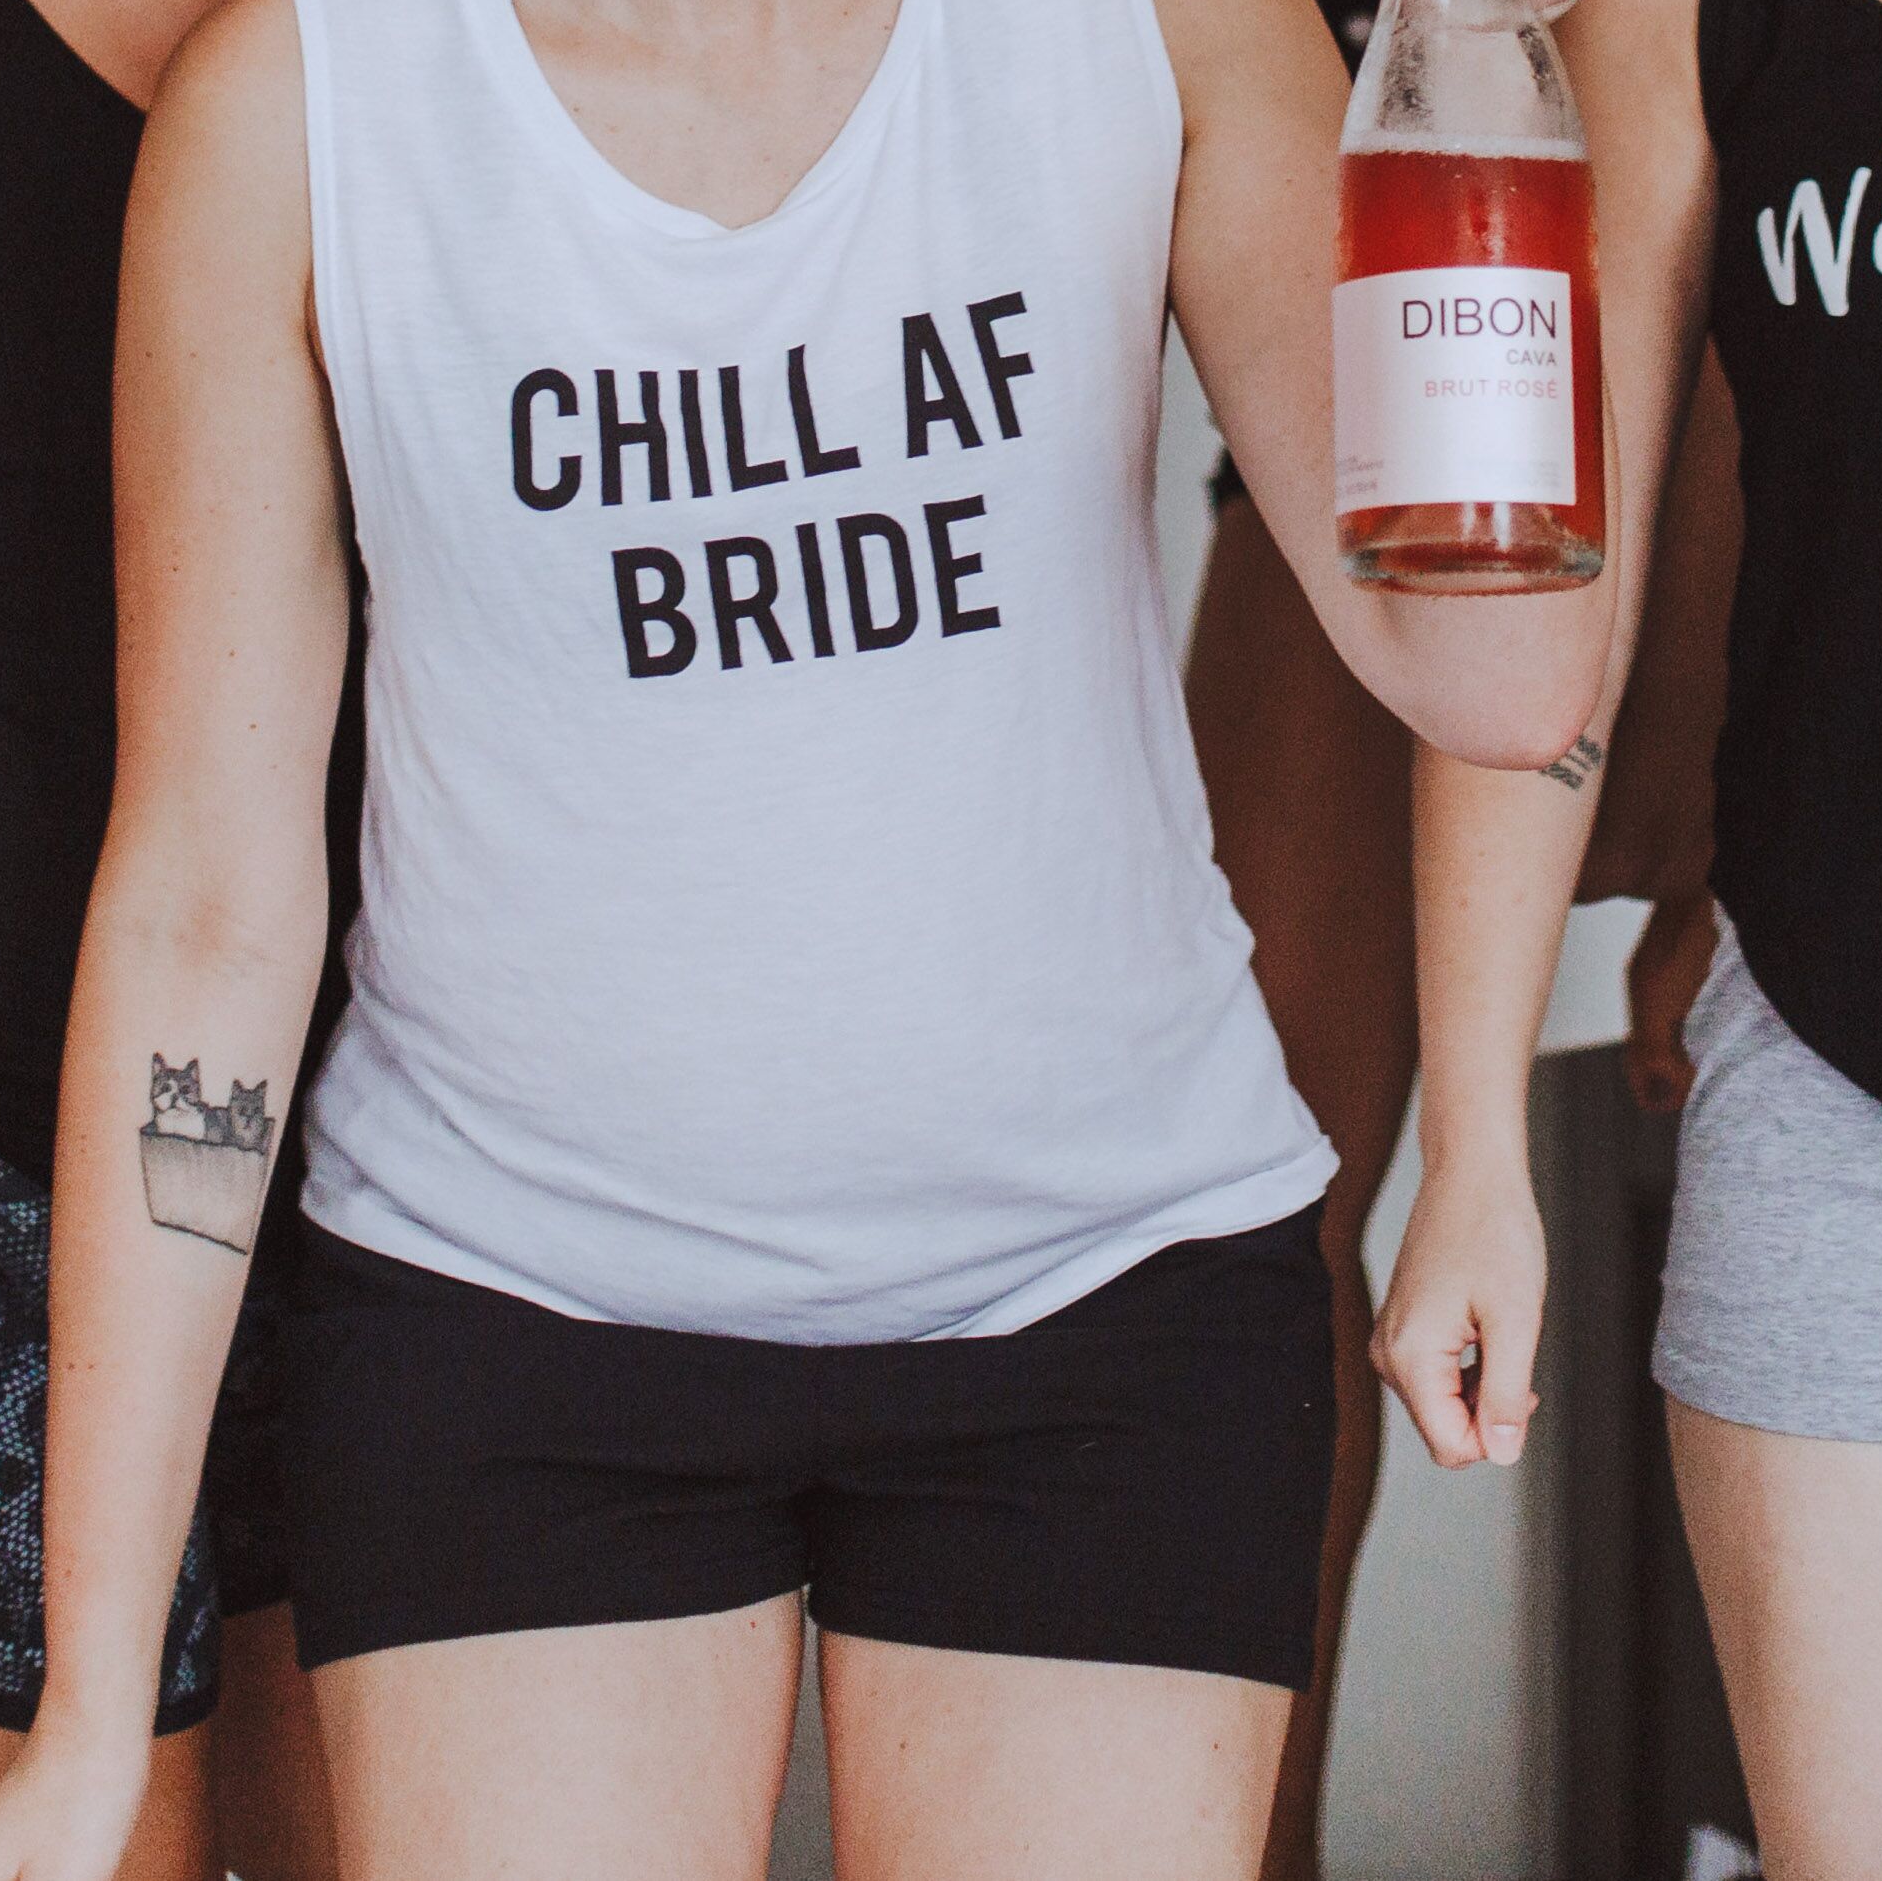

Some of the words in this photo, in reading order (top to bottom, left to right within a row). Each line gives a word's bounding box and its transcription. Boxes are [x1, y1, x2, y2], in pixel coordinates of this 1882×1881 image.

[1403, 297, 1556, 340] DIBON
[1506, 349, 1557, 366] CAVA
[511, 344, 862, 512] CHILL
[902, 291, 1035, 459] AF
[1425, 379, 1487, 397] BRUT
[1498, 377, 1558, 399] ROSÉ
[611, 494, 1002, 680] BRIDE
